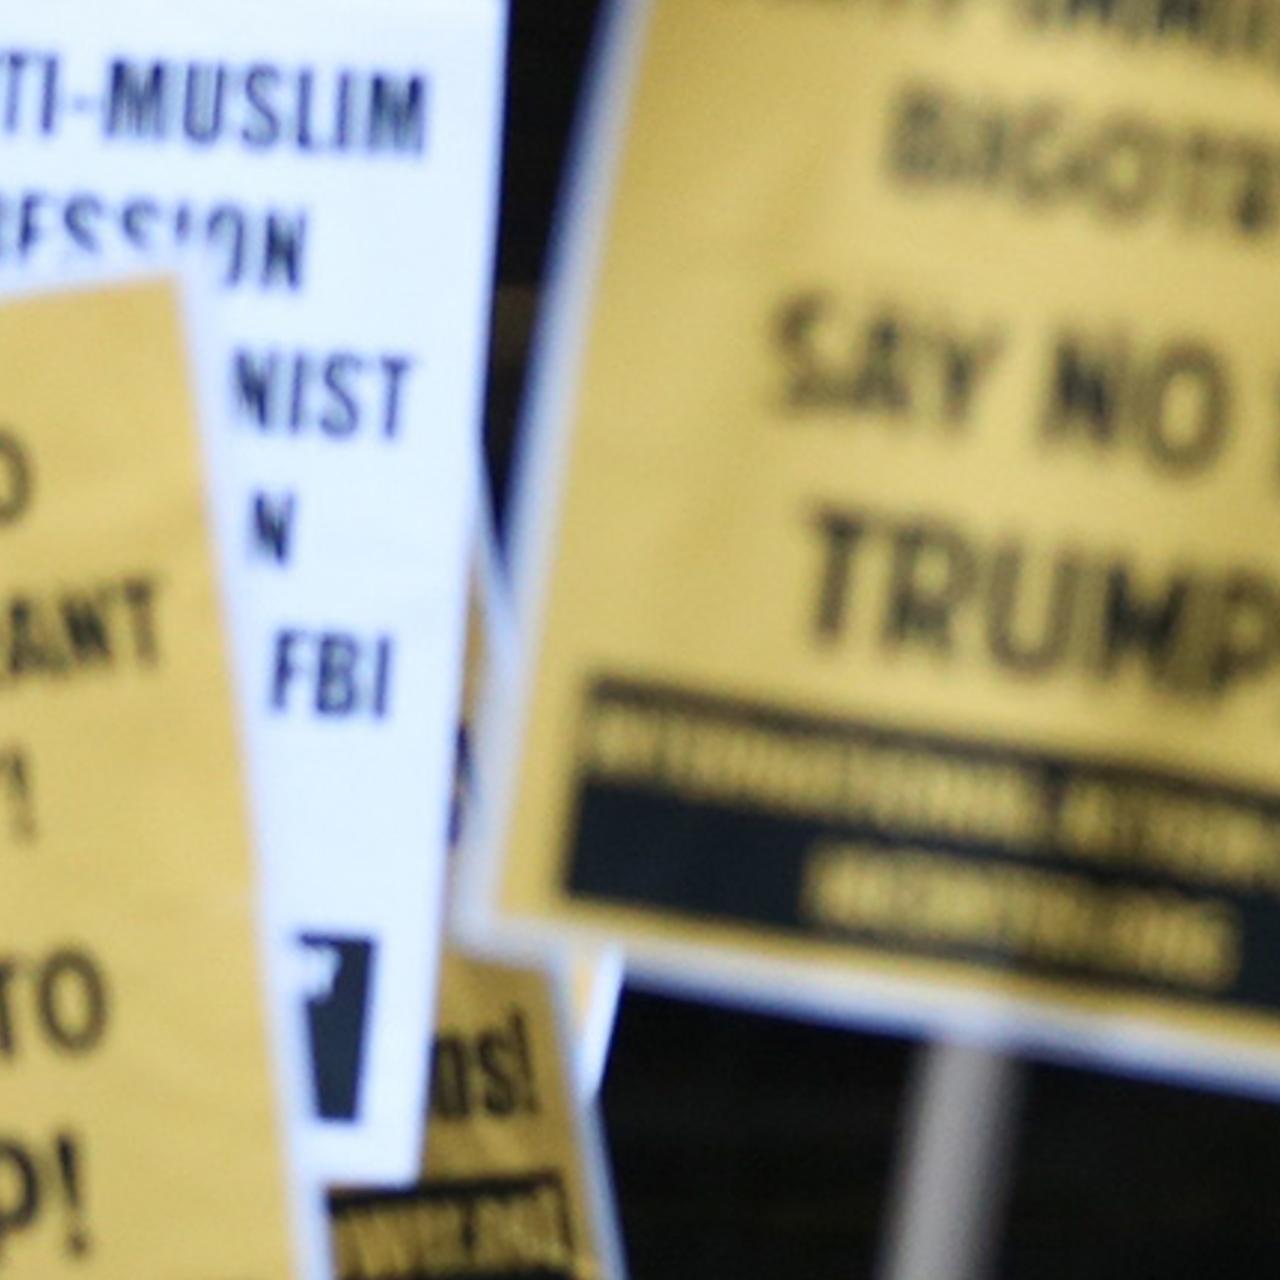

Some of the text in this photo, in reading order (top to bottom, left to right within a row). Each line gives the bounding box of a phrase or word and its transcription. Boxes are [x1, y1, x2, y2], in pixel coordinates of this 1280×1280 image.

[768, 288, 1005, 440] SAY
[1035, 320, 1240, 482] NO
[270, 626, 395, 719] FBI
